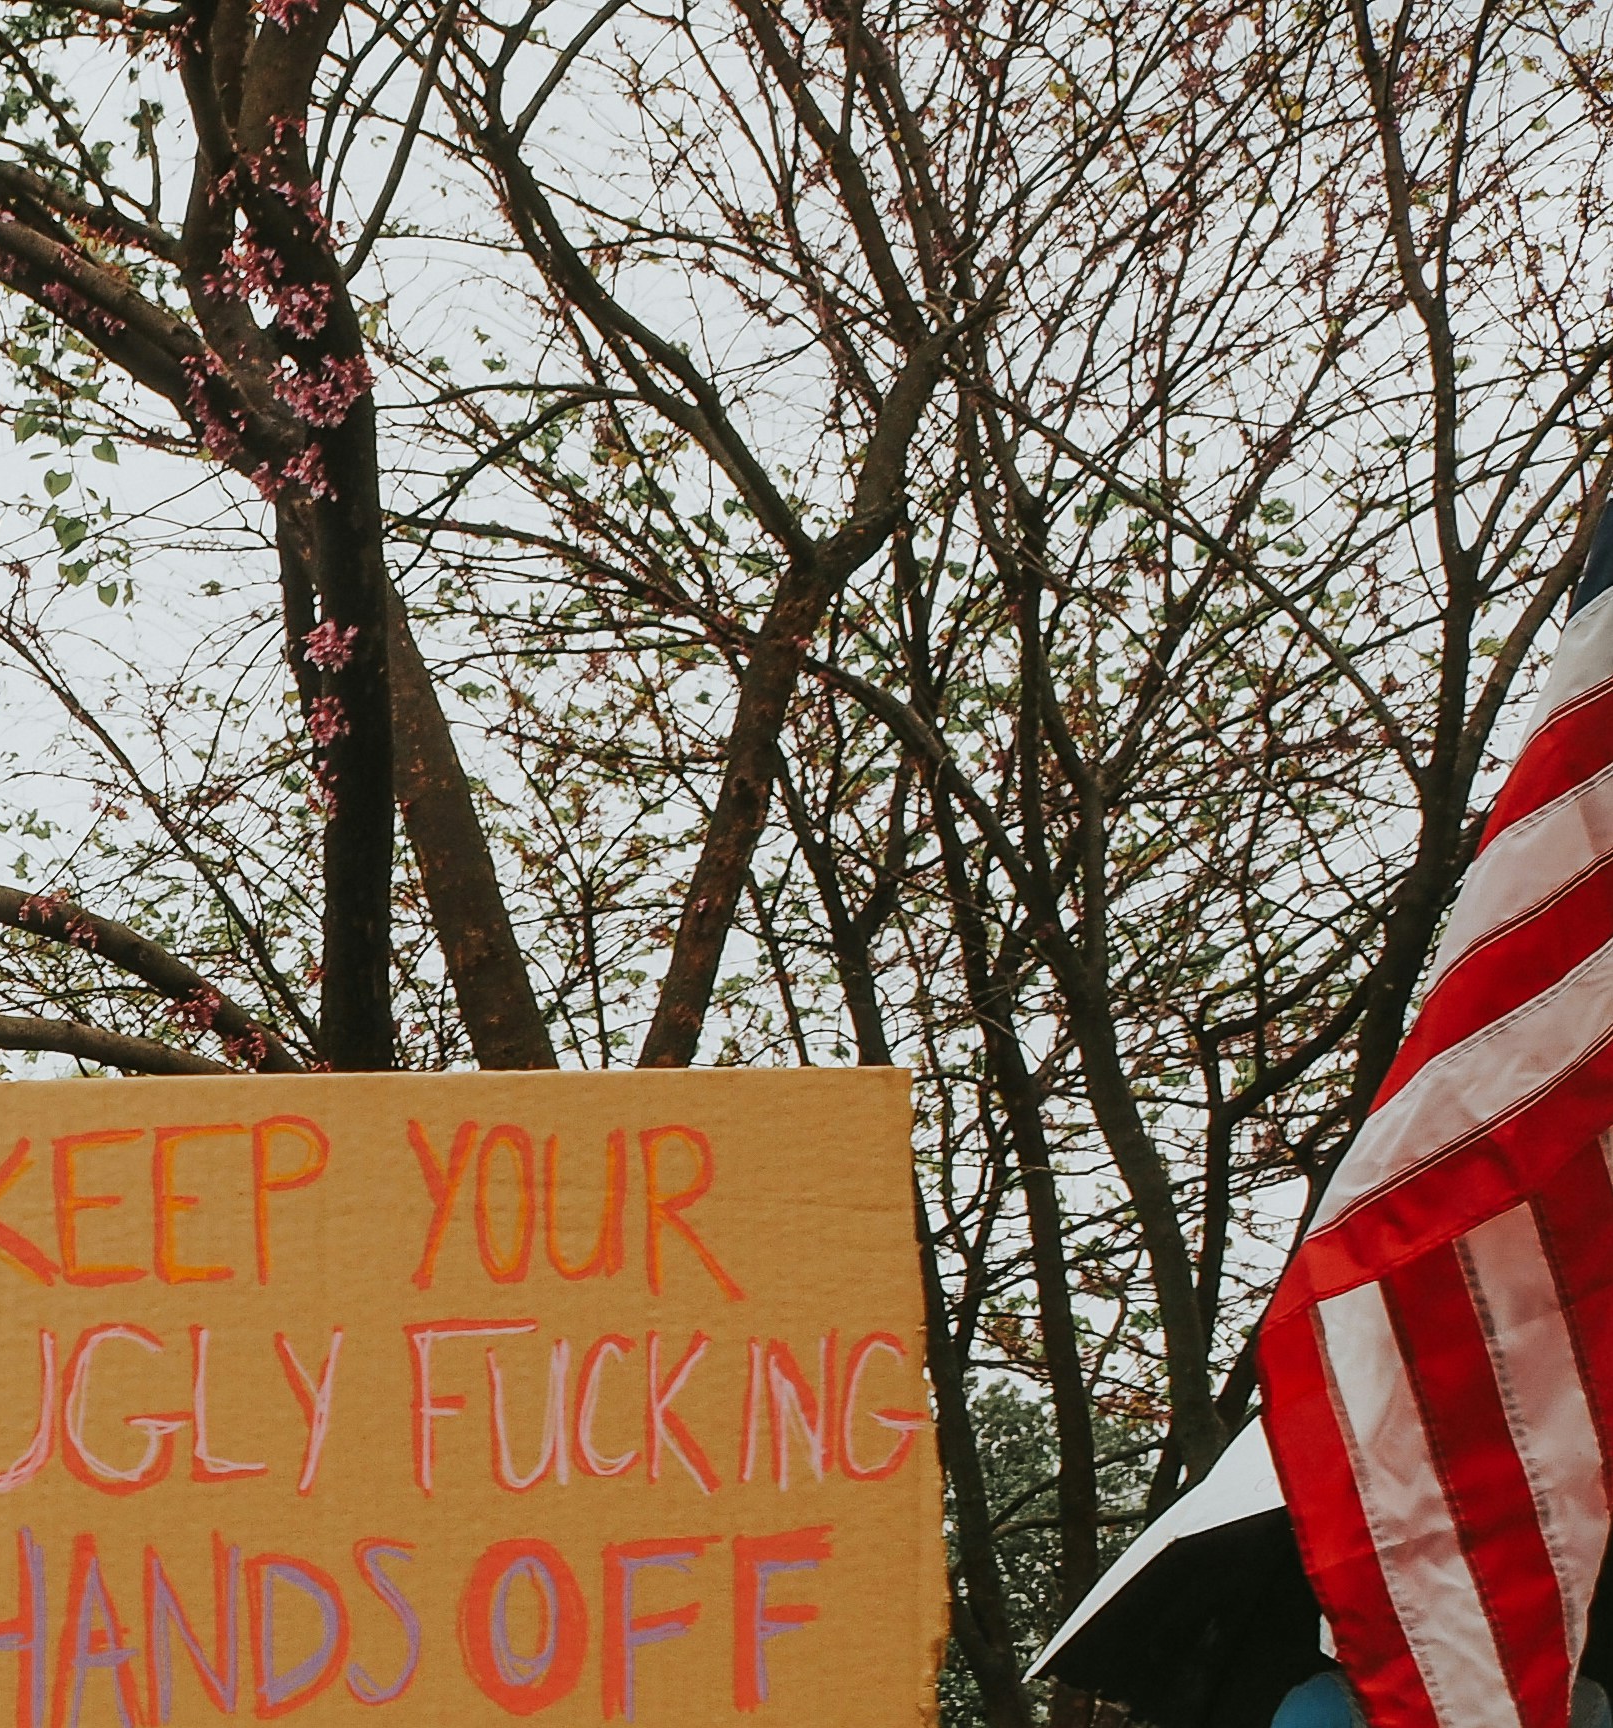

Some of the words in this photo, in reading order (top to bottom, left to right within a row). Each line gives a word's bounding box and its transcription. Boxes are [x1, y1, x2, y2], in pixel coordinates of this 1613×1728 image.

[407, 1119, 746, 1301] YOUR
[403, 1317, 924, 1496] FUCKING
[457, 1524, 834, 1723] OFF
